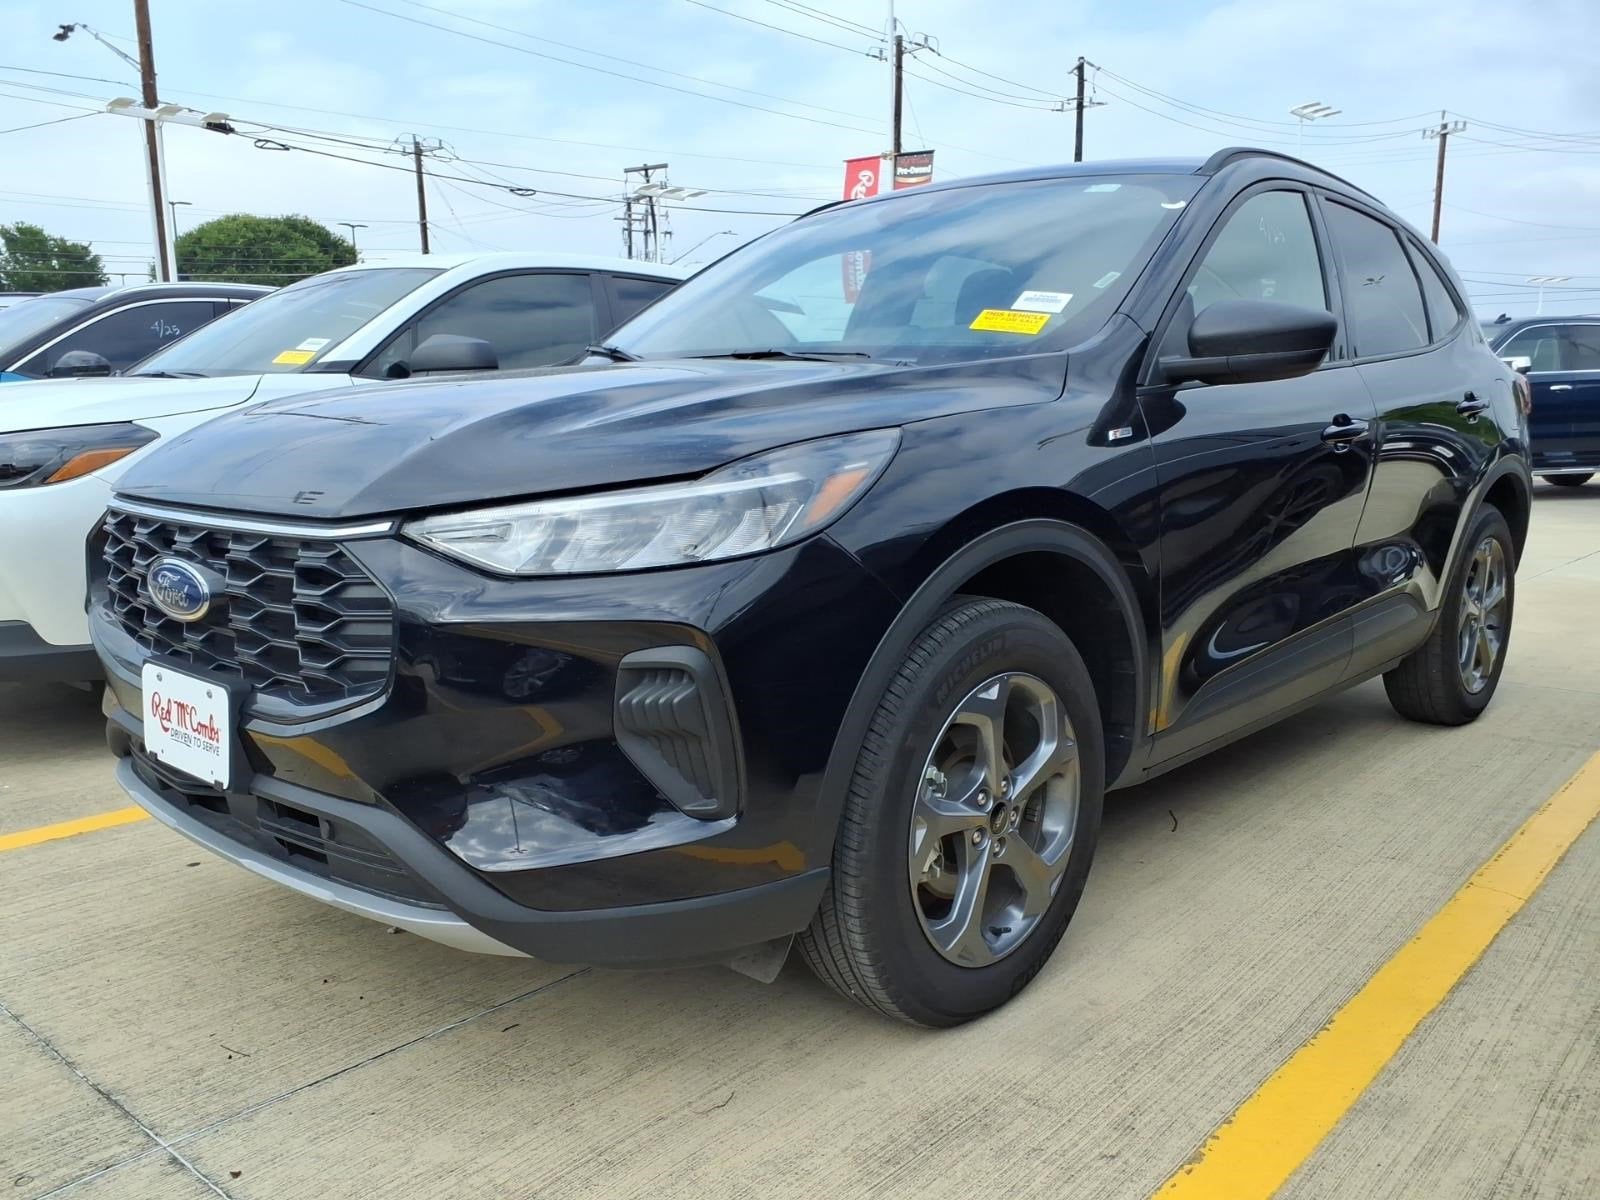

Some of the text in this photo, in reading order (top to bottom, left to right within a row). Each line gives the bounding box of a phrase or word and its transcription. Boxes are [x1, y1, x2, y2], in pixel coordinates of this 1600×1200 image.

[150, 319, 180, 338] 4/25
[157, 571, 189, 608] Ford
[151, 691, 220, 743] Red McCombs
[170, 728, 220, 756] DRIVEN TO SERVE
